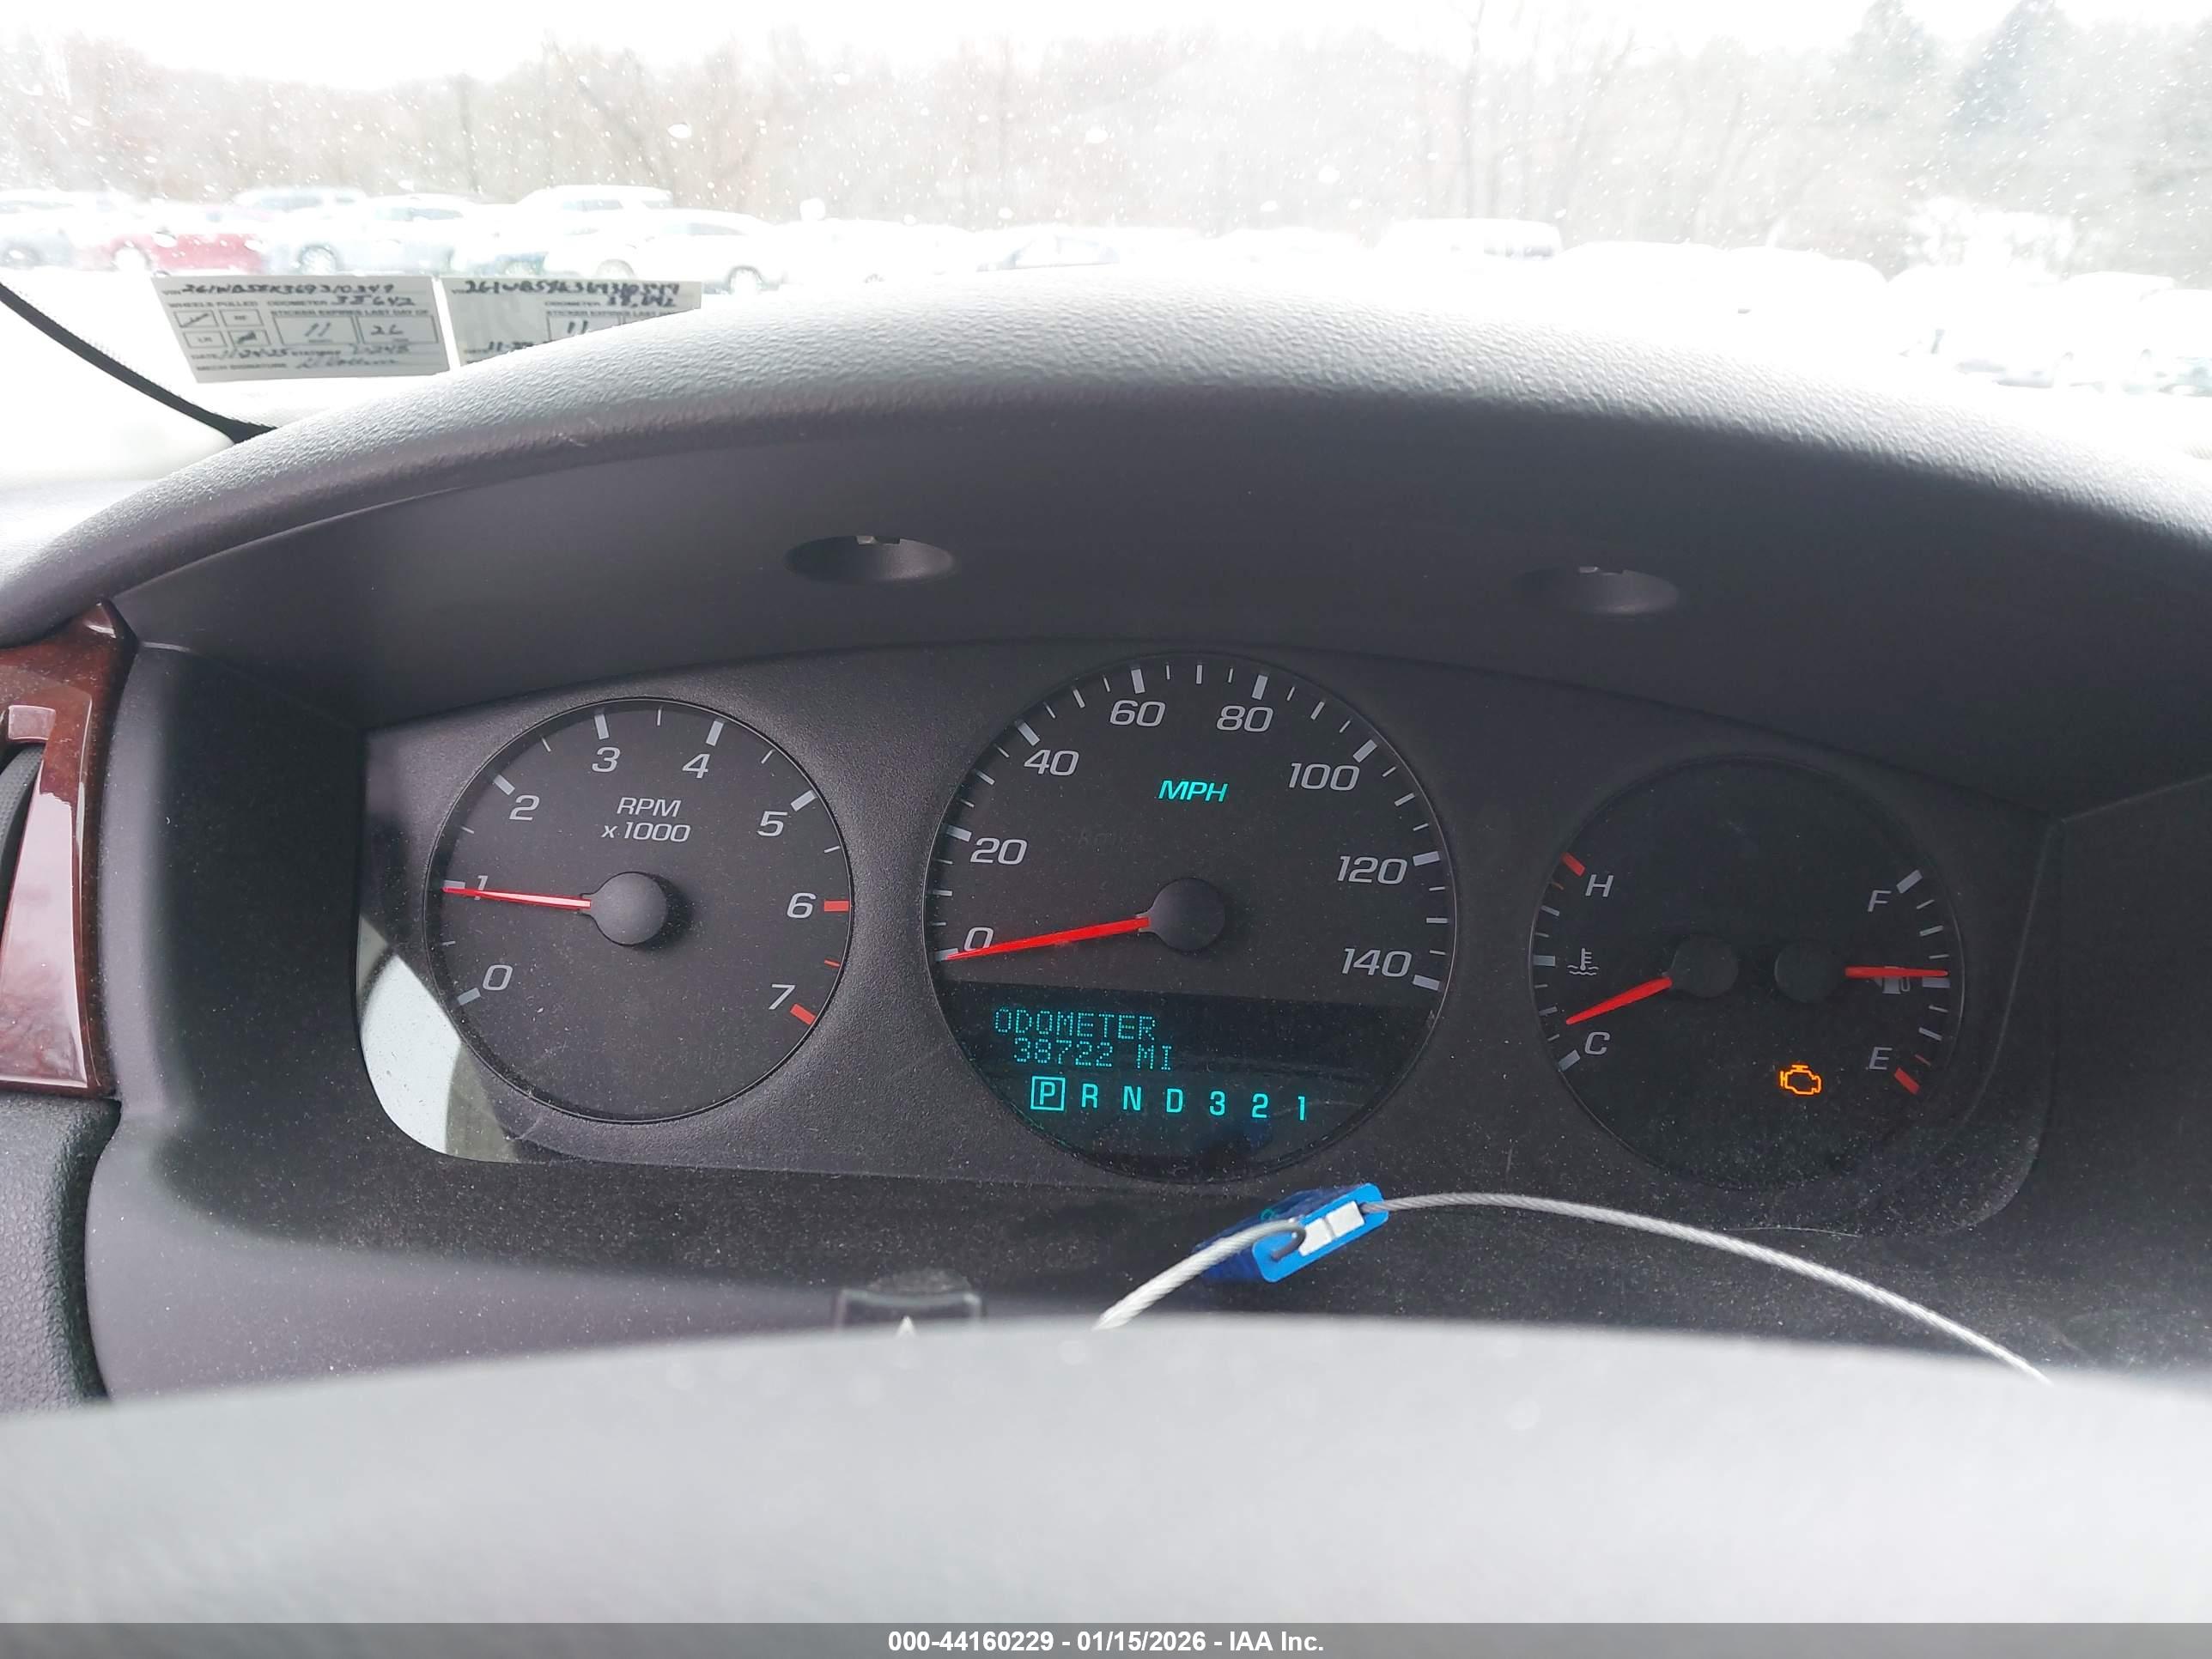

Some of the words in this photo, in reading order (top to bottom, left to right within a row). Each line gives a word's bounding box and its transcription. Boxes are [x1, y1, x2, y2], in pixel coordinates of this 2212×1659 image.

[1109, 701, 1166, 727] 60
[1216, 705, 1273, 733] 80
[592, 746, 621, 773] 3
[682, 753, 711, 779] 4
[1024, 749, 1080, 776] 40
[1289, 763, 1360, 792] 100
[1158, 780, 1229, 803] MPH
[509, 794, 540, 821] 2
[617, 796, 682, 817] RPM
[757, 811, 787, 837] 5
[969, 837, 1028, 865] 20
[1336, 856, 1407, 884] 120
[474, 875, 488, 901] 1
[1585, 874, 1614, 898] H
[787, 892, 817, 919] 6
[1868, 890, 1892, 912] F
[964, 927, 994, 952] 0
[1342, 948, 1413, 977] 140
[482, 964, 514, 991] 0
[769, 984, 796, 1010] 7
[994, 1006, 1157, 1041] ODOMETER
[1013, 1036, 1115, 1068] 38722
[1135, 1043, 1173, 1072] MI
[1584, 1031, 1611, 1055] C
[1869, 1046, 1893, 1071] E
[1038, 1081, 1056, 1105] P
[1081, 1083, 1098, 1109] R
[1123, 1085, 1142, 1111] N
[1166, 1088, 1184, 1113] D
[1208, 1091, 1226, 1115] 3
[1251, 1092, 1269, 1119] 2
[1297, 1096, 1306, 1121] 1
